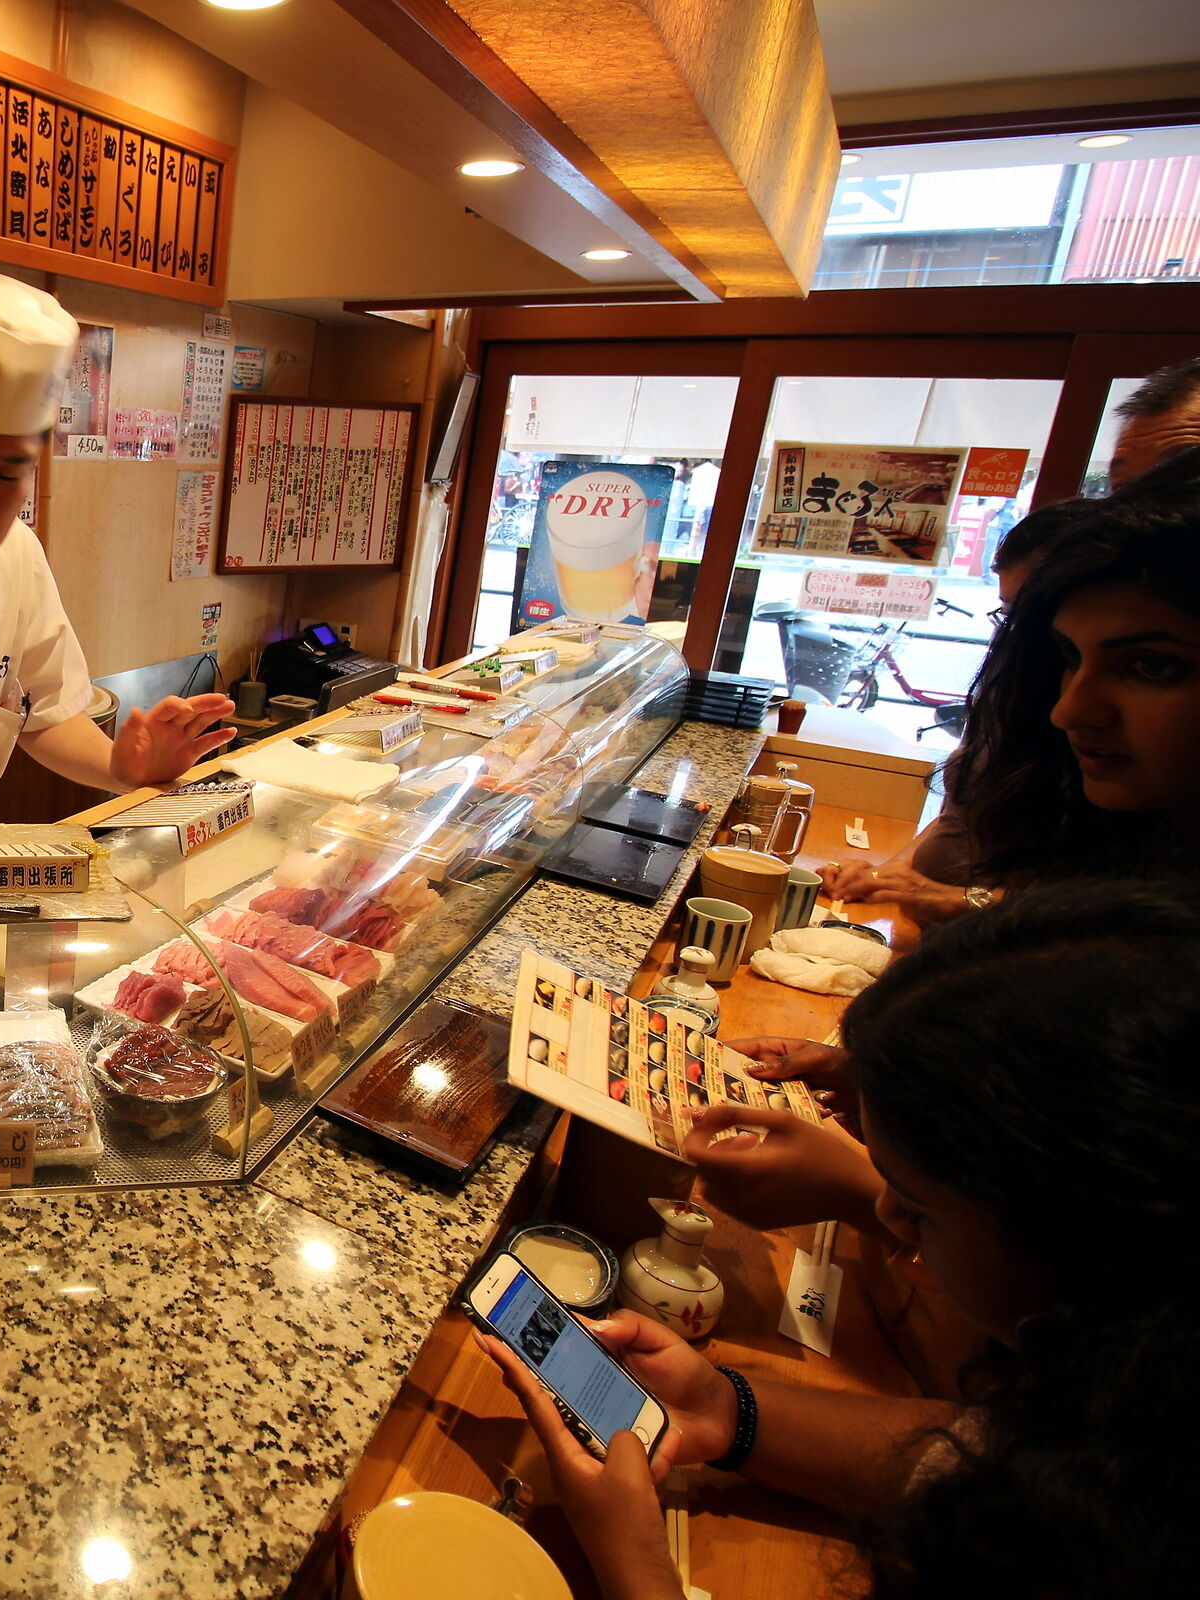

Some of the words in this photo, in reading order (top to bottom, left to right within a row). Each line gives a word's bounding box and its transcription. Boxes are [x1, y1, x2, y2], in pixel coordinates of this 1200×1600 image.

[34, 107, 52, 237] あなご
[55, 116, 74, 242] しめさば
[118, 139, 137, 256] まぐろ
[139, 148, 158, 262] たい
[160, 155, 177, 267] えび
[178, 161, 196, 273] いか
[586, 483, 632, 494] SUPER
